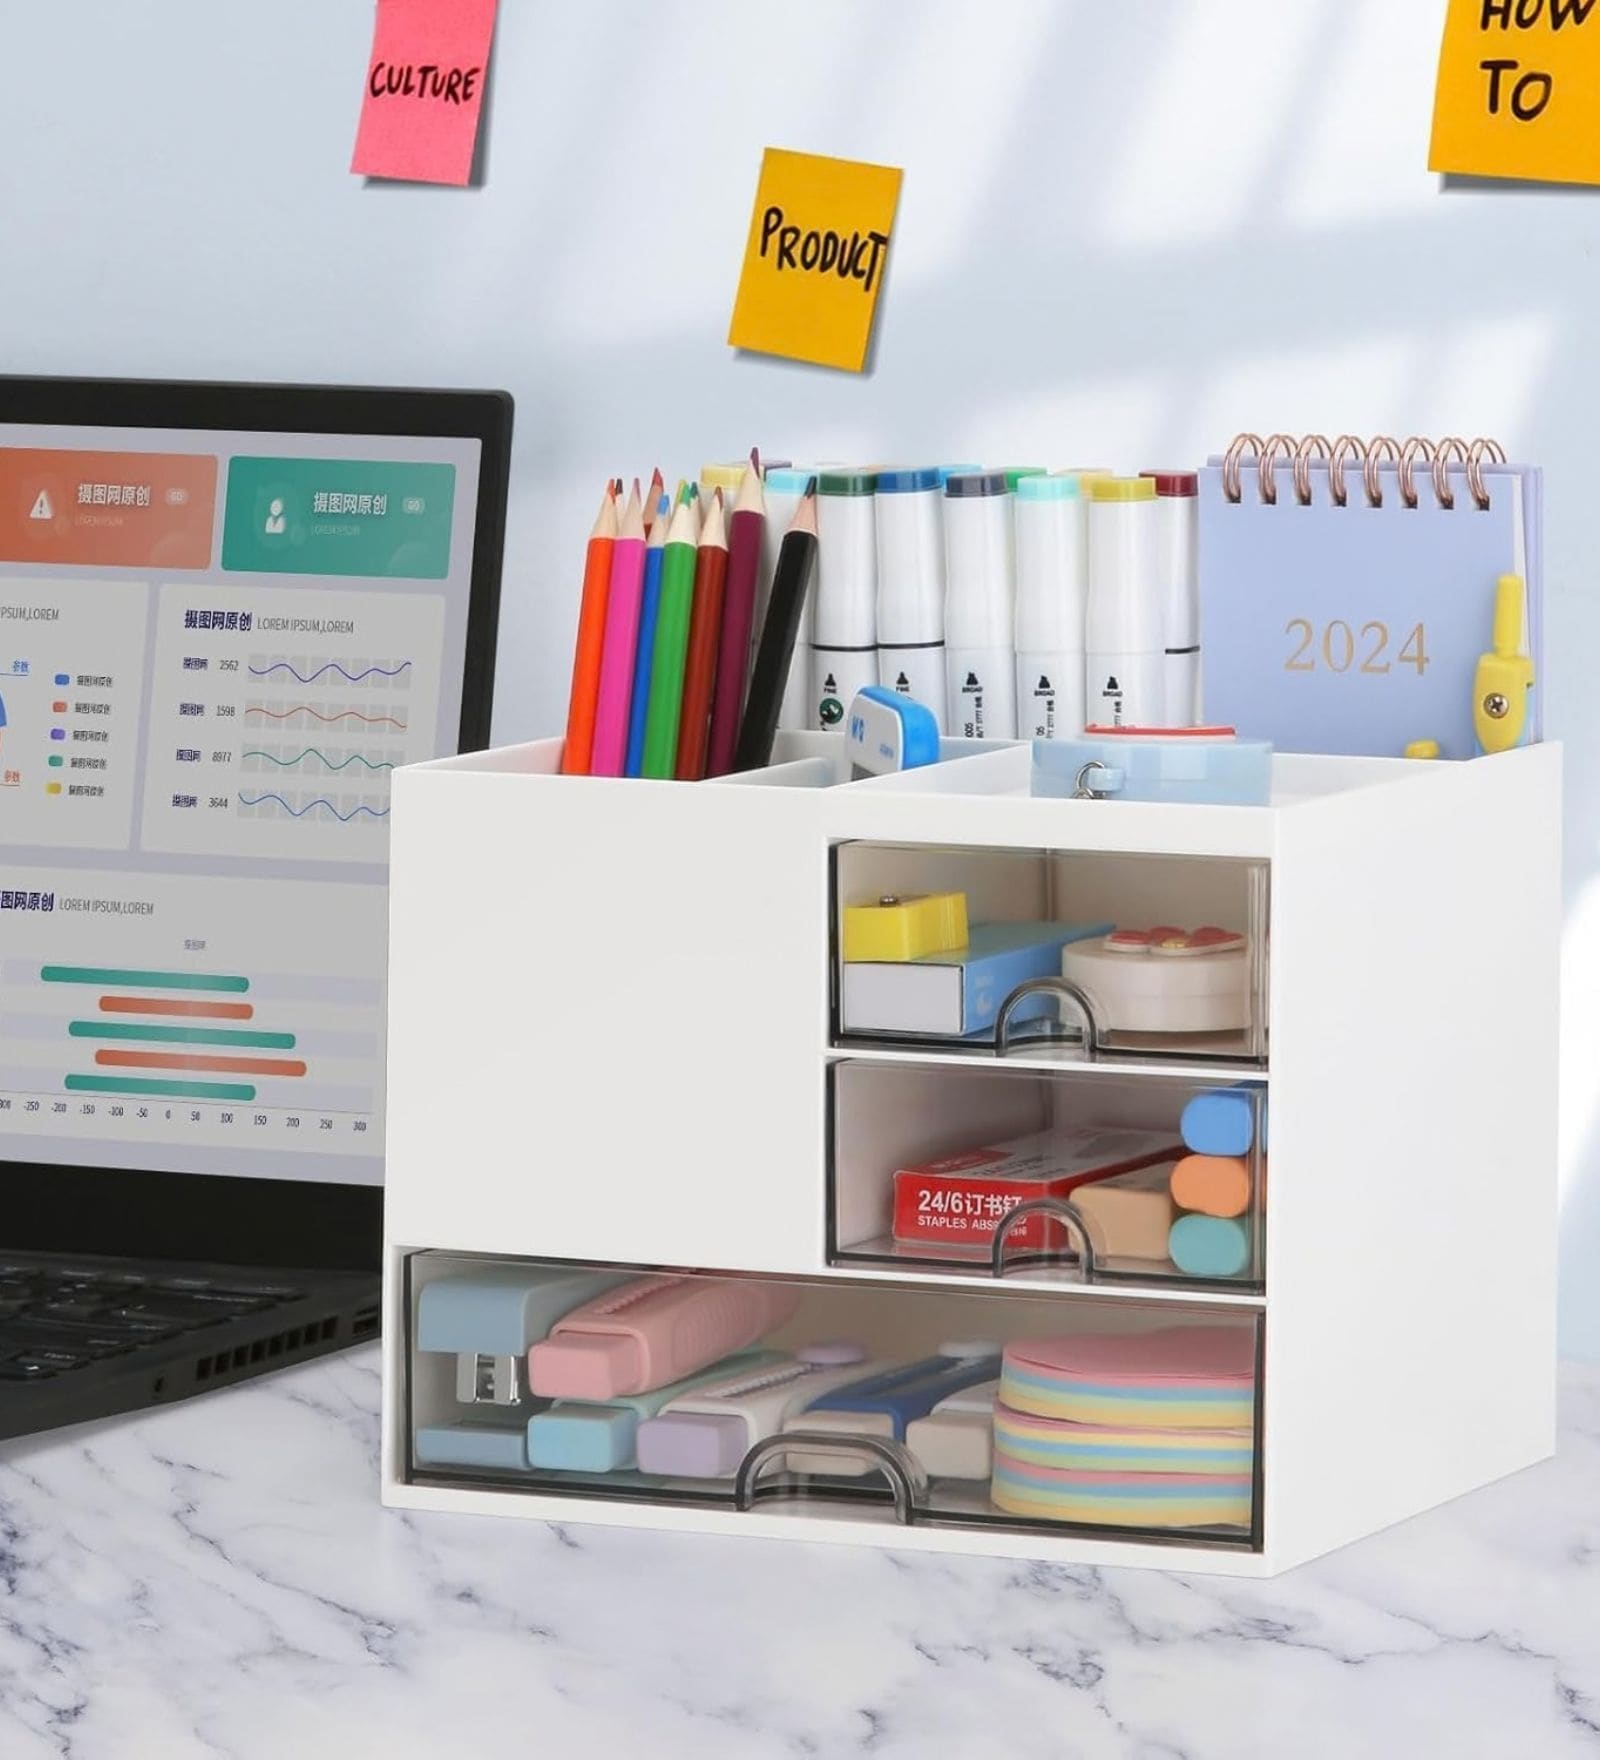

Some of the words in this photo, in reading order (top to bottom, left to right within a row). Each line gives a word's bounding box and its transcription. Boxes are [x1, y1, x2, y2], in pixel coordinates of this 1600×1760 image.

[1481, 0, 1597, 31] HOW
[370, 61, 480, 105] CULTURE
[1480, 60, 1552, 121] TO
[761, 206, 888, 293] PRODUCT
[78, 483, 151, 506] 摄图网原创
[313, 491, 387, 516] 摄图网原创
[185, 610, 252, 631] 摄图网原创
[257, 617, 290, 631] LOREM
[1284, 618, 1430, 676] 2024
[219, 660, 239, 671] 2562
[0, 891, 54, 912] 图网原创
[59, 898, 90, 912] LOREM
[136, 1108, 148, 1118] -50
[254, 1114, 267, 1125] 150
[918, 1215, 967, 1229] STAPLES
